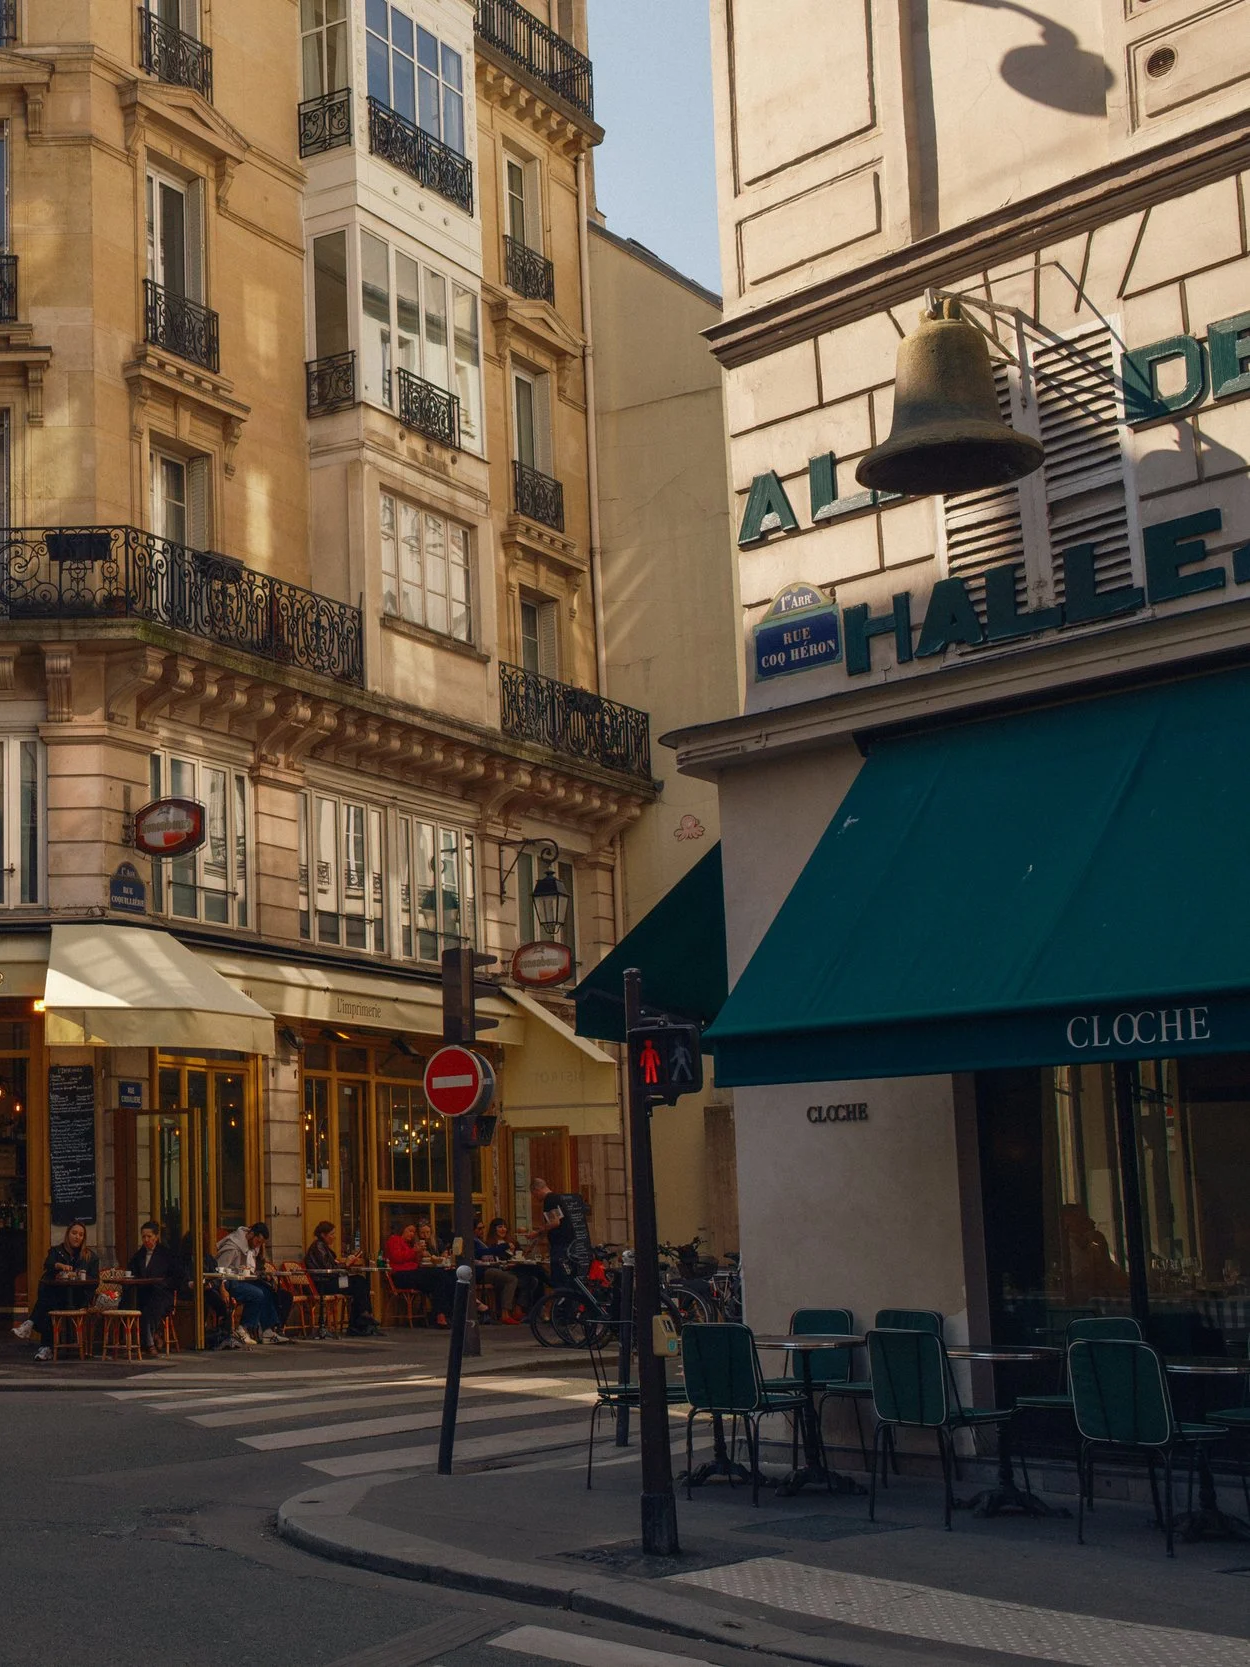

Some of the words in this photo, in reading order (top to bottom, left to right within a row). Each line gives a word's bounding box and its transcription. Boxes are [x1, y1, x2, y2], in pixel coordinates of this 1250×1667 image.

[843, 507, 1250, 677] HALLE
[783, 626, 811, 646] RUE
[761, 652, 786, 668] COQ
[790, 638, 836, 661] HÉRON
[123, 886, 134, 895] RUE
[337, 997, 382, 1019] L'imprimerie
[1066, 1006, 1211, 1049] CLOCHE
[806, 1102, 869, 1124] CLOCHE
